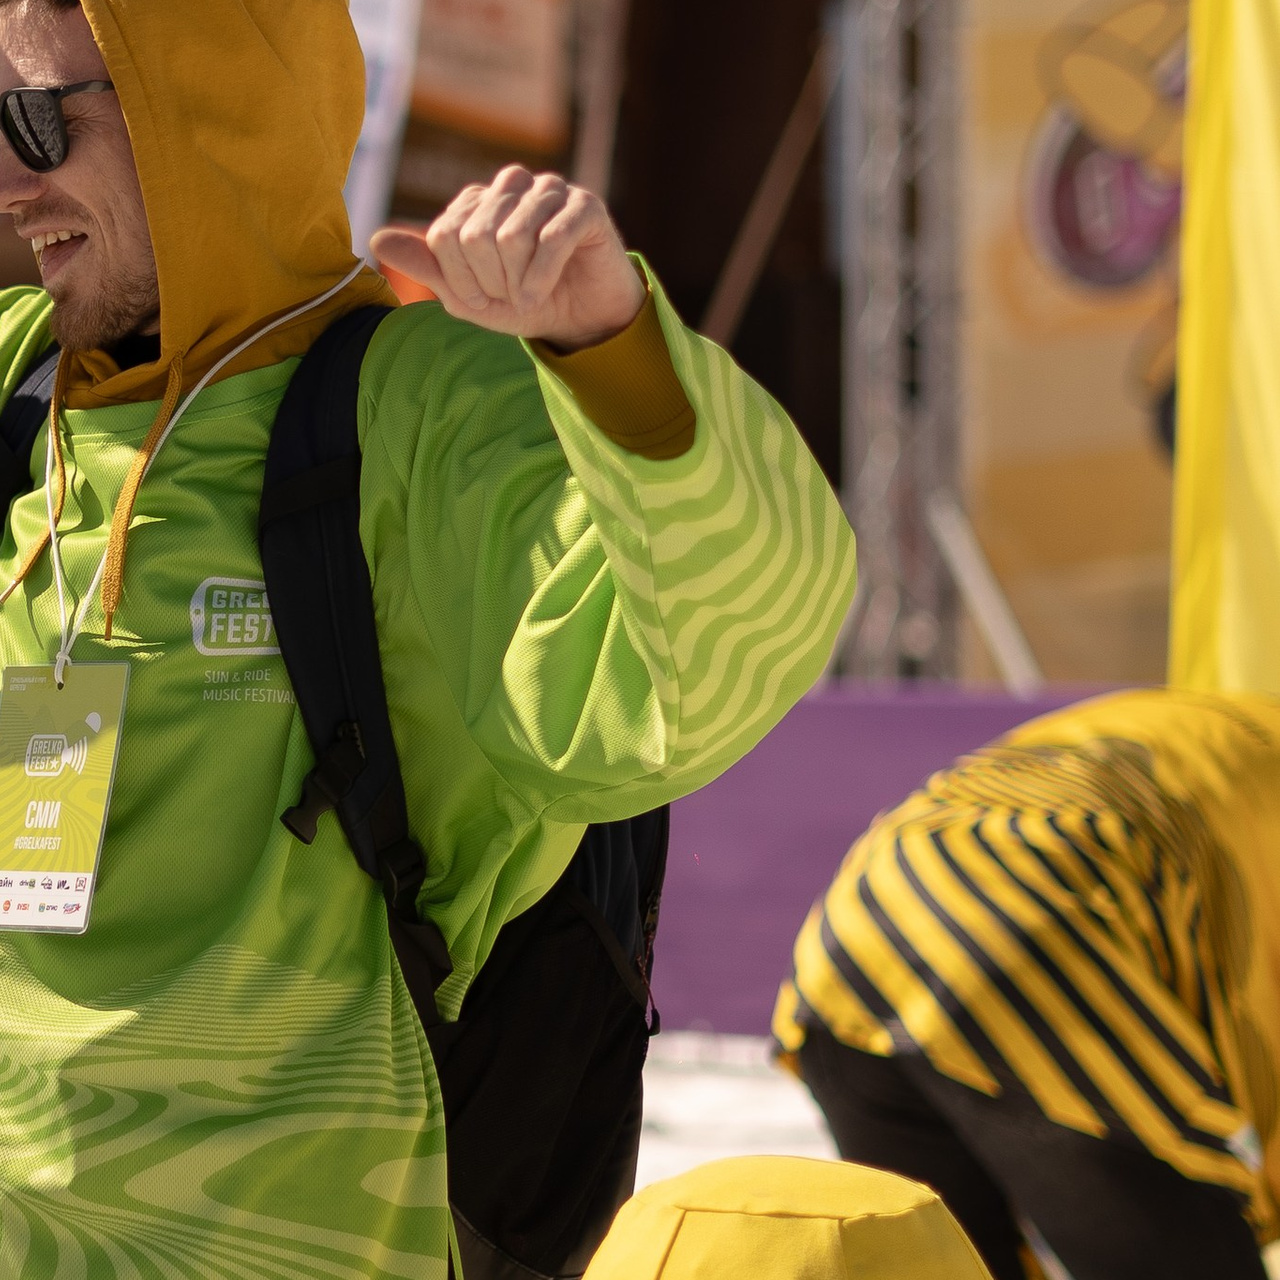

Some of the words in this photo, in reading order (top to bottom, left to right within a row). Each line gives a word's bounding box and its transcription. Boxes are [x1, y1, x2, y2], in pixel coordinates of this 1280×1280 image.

[210, 613, 273, 643] FEST
[204, 670, 229, 684] SUN
[231, 672, 241, 682] &
[243, 668, 271, 681] RIDE
[203, 688, 242, 701] MUSIC
[244, 688, 295, 704] FESTIVAL
[31, 740, 63, 755] GRELKA
[29, 756, 51, 770] FEST
[25, 801, 61, 829] СМИ
[14, 836, 62, 850] #GRELKAFEST
